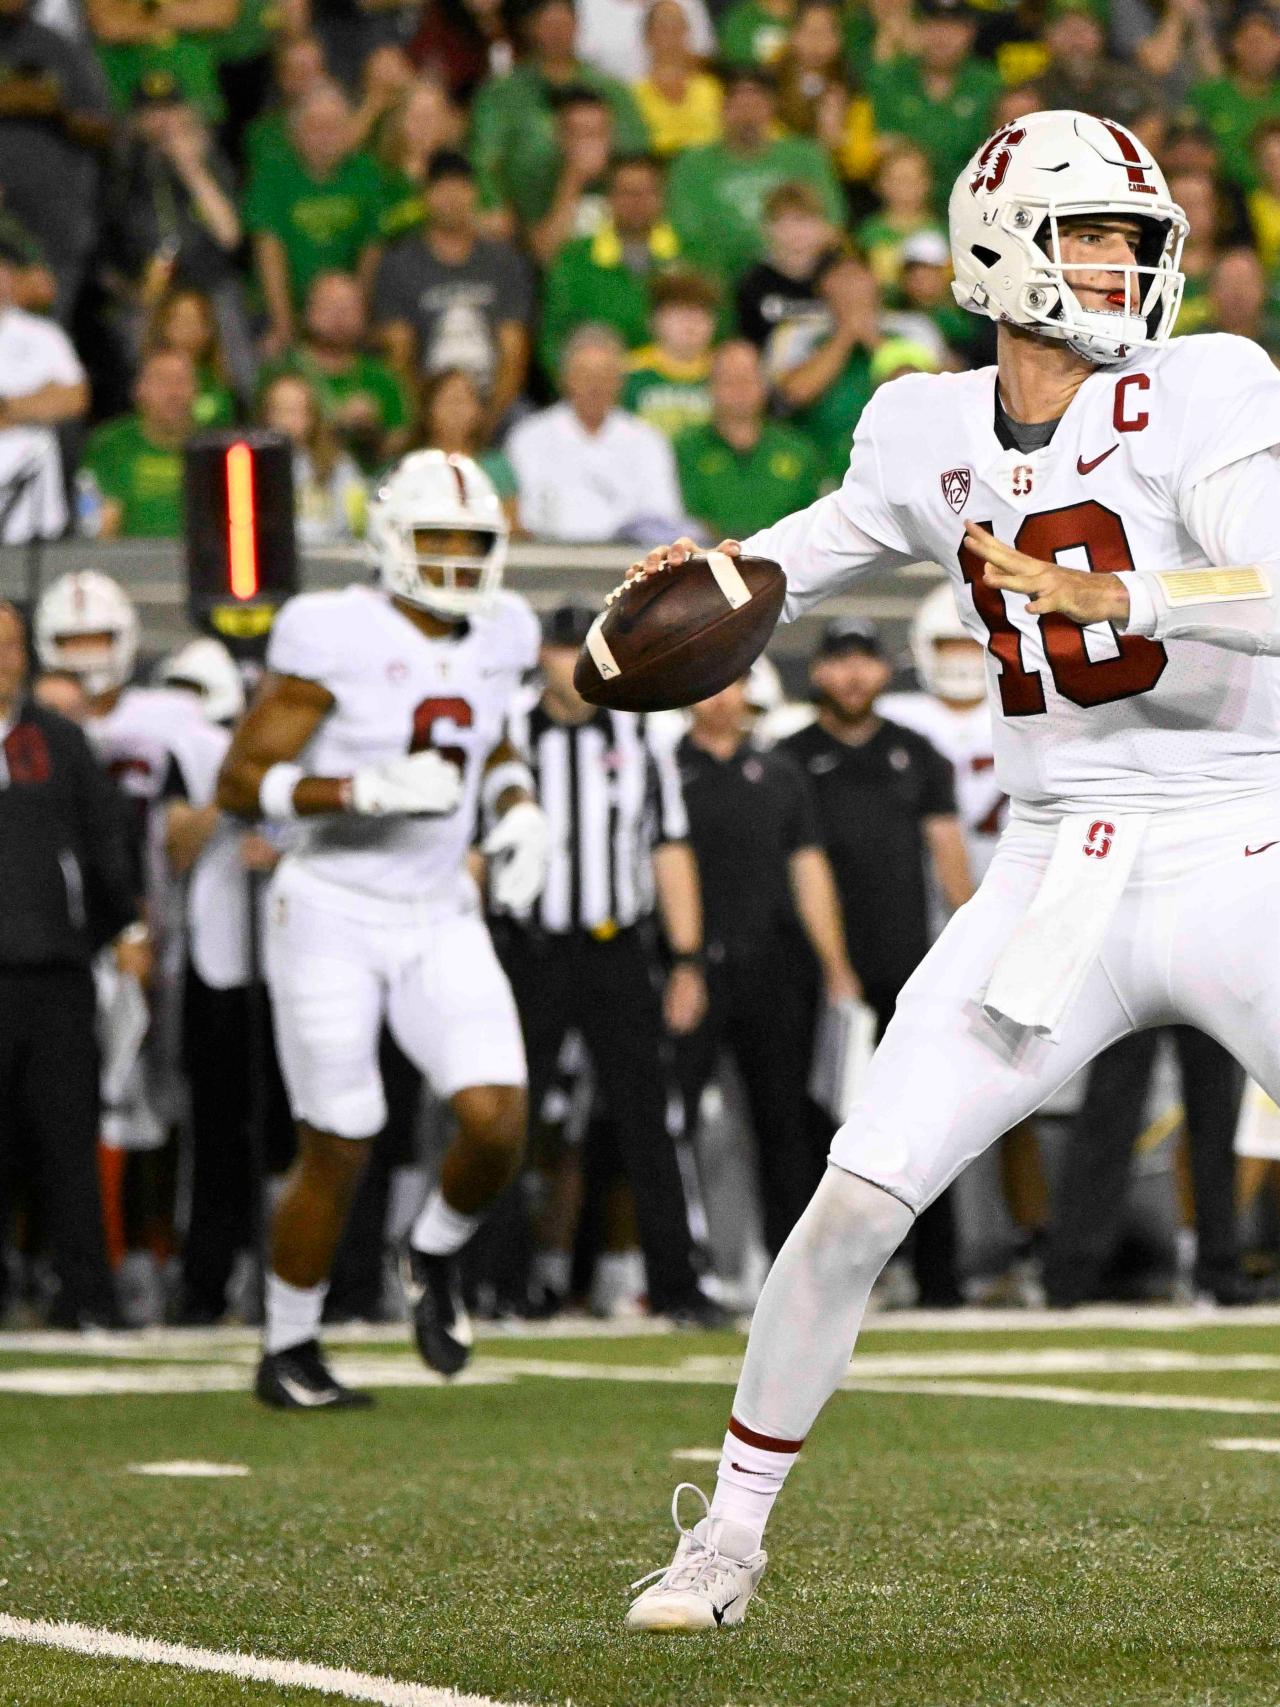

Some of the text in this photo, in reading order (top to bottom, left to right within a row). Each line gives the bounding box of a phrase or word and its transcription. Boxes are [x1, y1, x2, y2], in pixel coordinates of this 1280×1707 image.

[1112, 372, 1150, 433] C
[942, 470, 968, 498] PAC
[950, 488, 963, 504] 12
